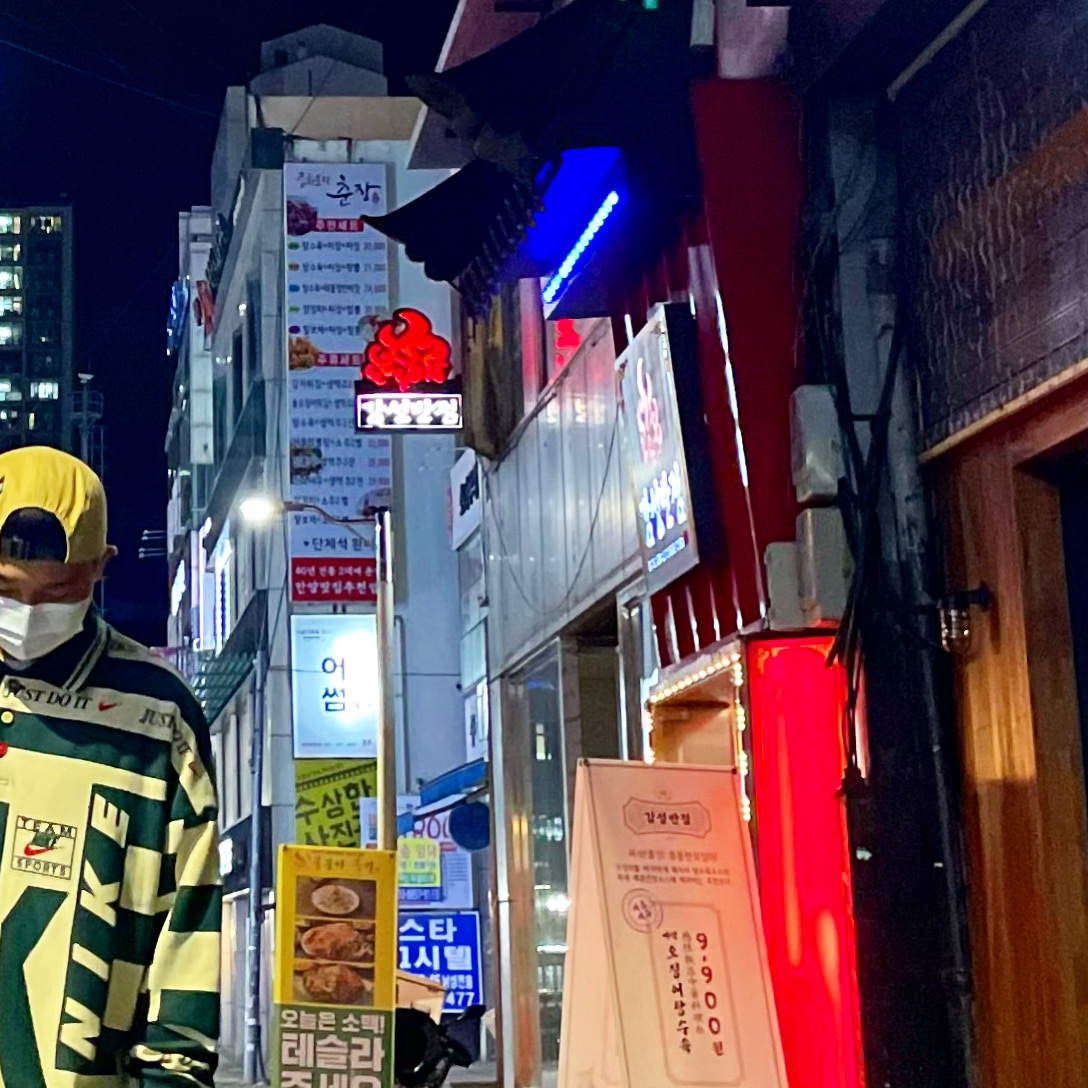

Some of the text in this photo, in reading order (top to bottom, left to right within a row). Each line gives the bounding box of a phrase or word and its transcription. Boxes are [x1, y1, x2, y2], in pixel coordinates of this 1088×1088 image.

[46, 691, 72, 708] DO
[73, 696, 94, 711] IT
[18, 816, 73, 838] TEAM
[17, 857, 67, 877] SPORTS
[60, 792, 130, 1062] NIKE
[398, 917, 458, 944] 스타
[280, 1008, 336, 1031] 오늘은
[280, 1033, 385, 1073] 테슬라
